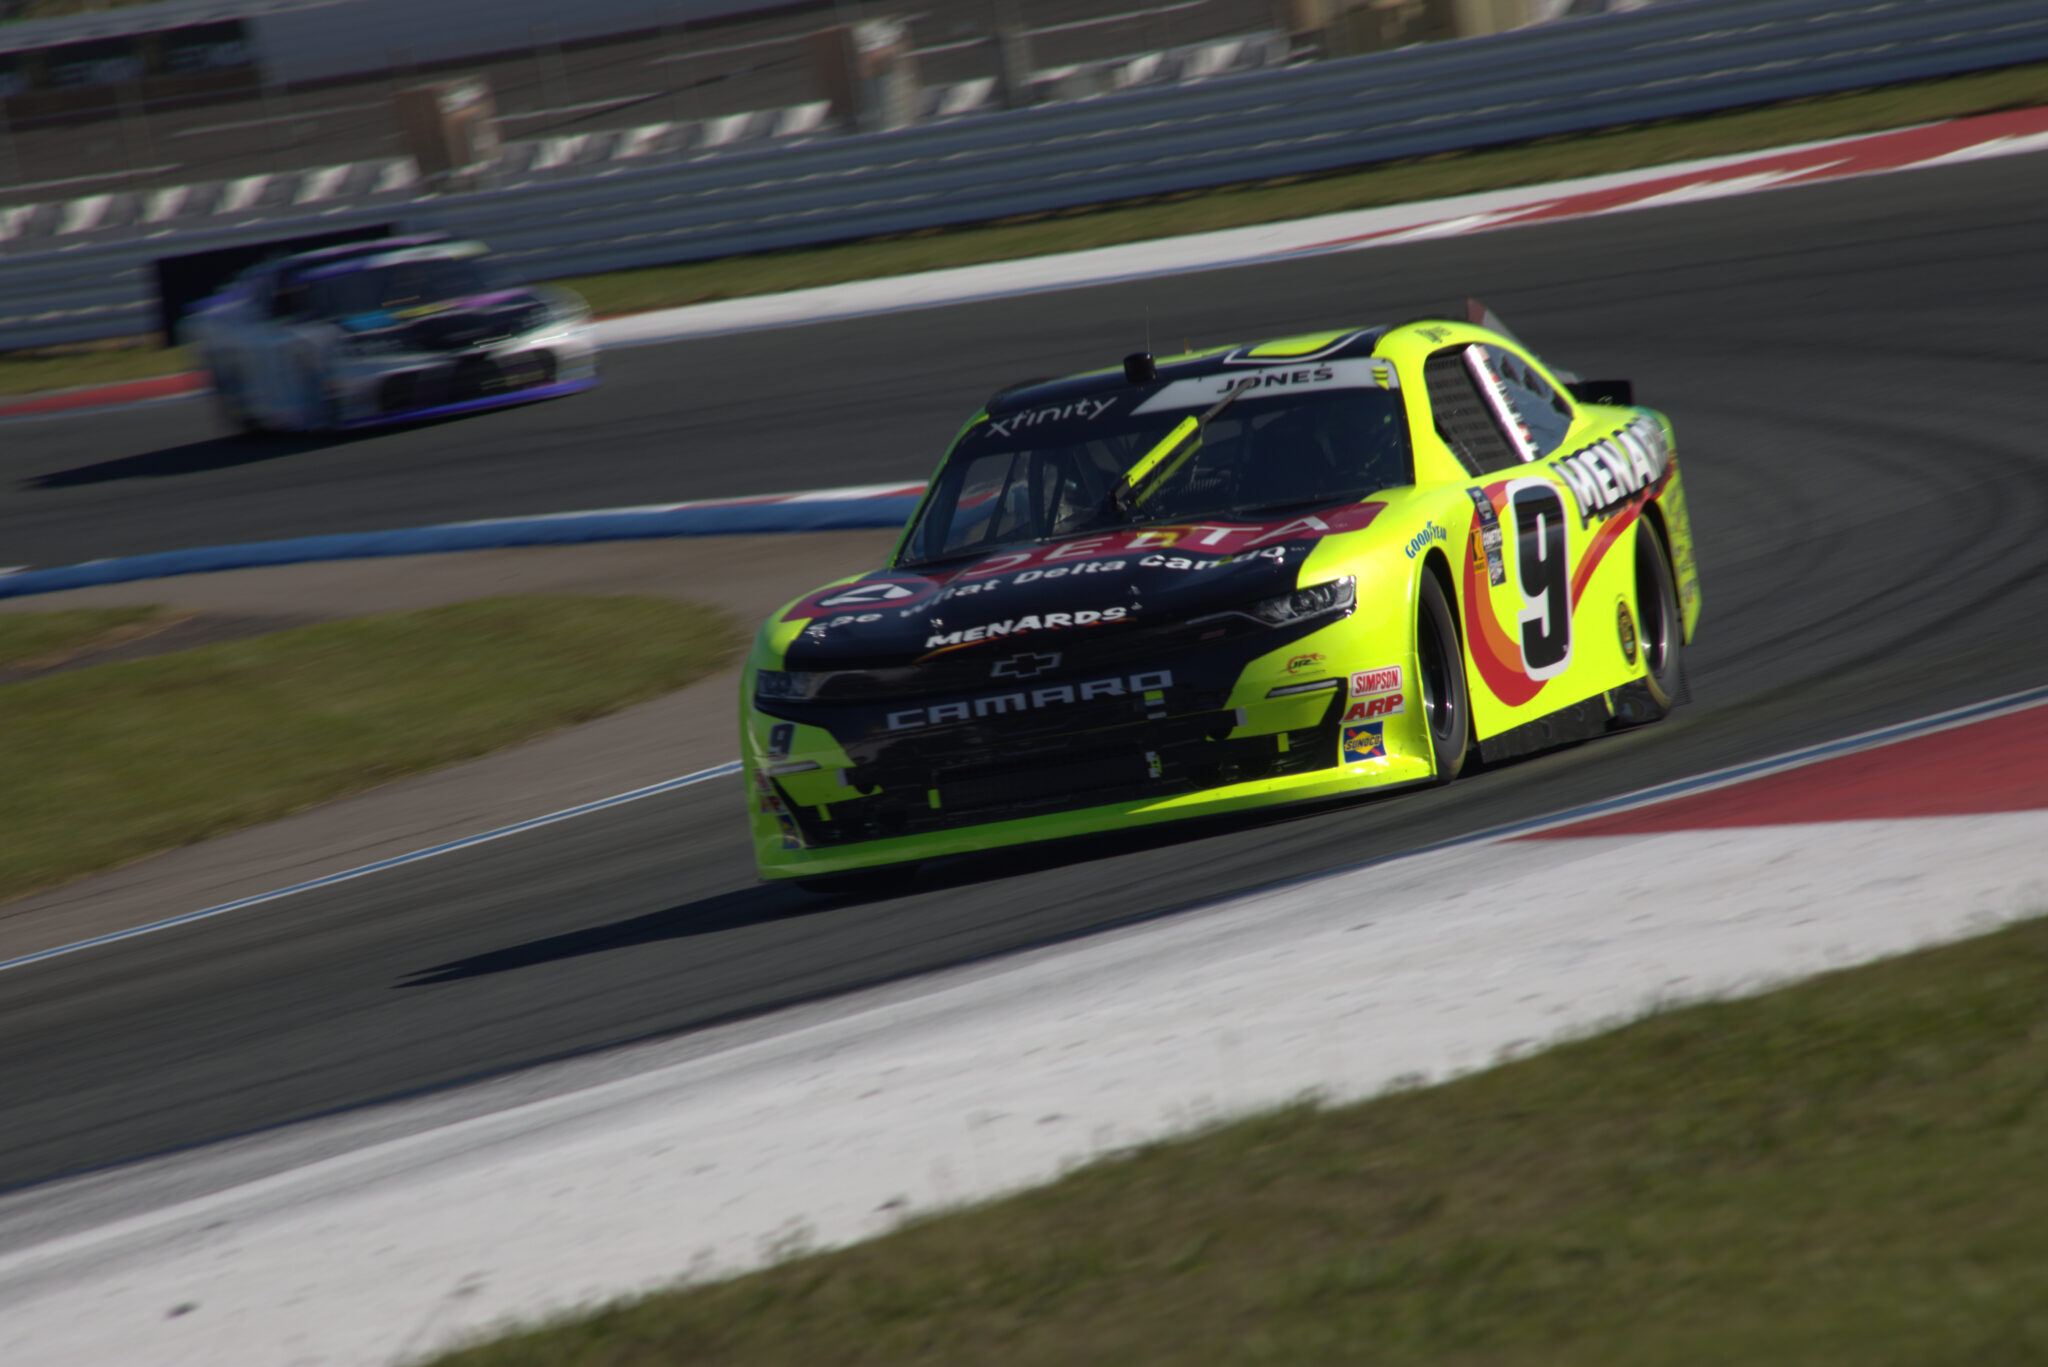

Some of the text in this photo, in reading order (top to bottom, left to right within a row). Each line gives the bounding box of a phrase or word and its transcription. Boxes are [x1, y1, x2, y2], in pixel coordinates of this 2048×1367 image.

[1217, 367, 1333, 394] JONES
[962, 514, 1330, 577] DELTA
[1012, 559, 1126, 585] Delta
[1511, 483, 1569, 671] 9
[925, 606, 1128, 648] MENARDS
[1355, 668, 1399, 694] SIMPSON
[886, 669, 1174, 730] CAMARO
[1344, 693, 1404, 720] ARP
[1345, 734, 1382, 751] SUNOCO
